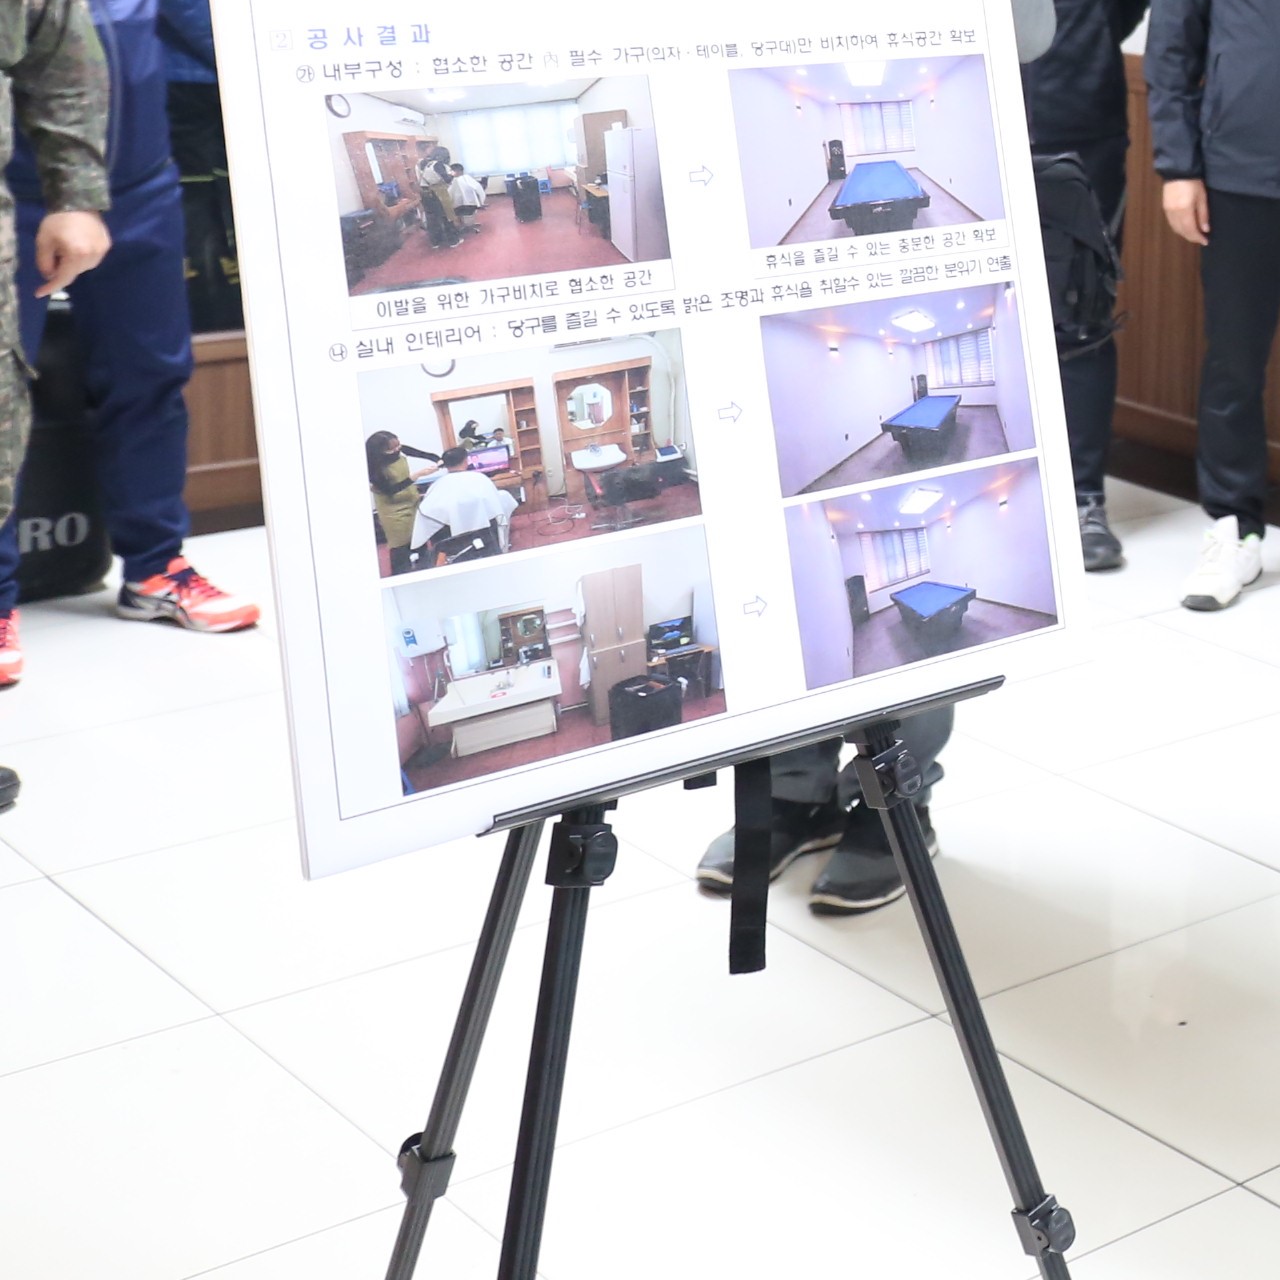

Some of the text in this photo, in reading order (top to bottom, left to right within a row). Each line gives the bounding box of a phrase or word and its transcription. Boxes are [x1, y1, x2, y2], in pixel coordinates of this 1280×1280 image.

[323, 60, 404, 81] 내부구성
[432, 54, 487, 75] 협소한
[498, 53, 533, 72] 공간
[569, 49, 603, 67] 필수
[614, 46, 681, 64] 가구(의자
[751, 37, 812, 57] 당구대)만
[820, 33, 879, 53] 비치하여
[887, 30, 943, 48] 휴식공간
[950, 28, 977, 44] 확보
[766, 227, 997, 269] 휴식을 즐길 수 있는 충분한 공간 확보
[356, 336, 395, 360] 실내
[405, 324, 483, 353] 인테리어
[507, 315, 558, 340] 당구를
[565, 309, 598, 331] 즐길
[606, 308, 622, 325] 수
[629, 297, 676, 322] 있도록
[682, 293, 713, 315] 밝은
[721, 287, 765, 309] 조명과
[771, 281, 813, 302] 휴식을
[820, 275, 860, 296] 취할수
[867, 270, 894, 290] 있는
[899, 265, 940, 285] 깔끔한
[945, 258, 984, 280] 분위기
[987, 255, 1012, 274] 연출
[376, 269, 653, 319] 이발을 위한 가구비치로 협소한 공간
